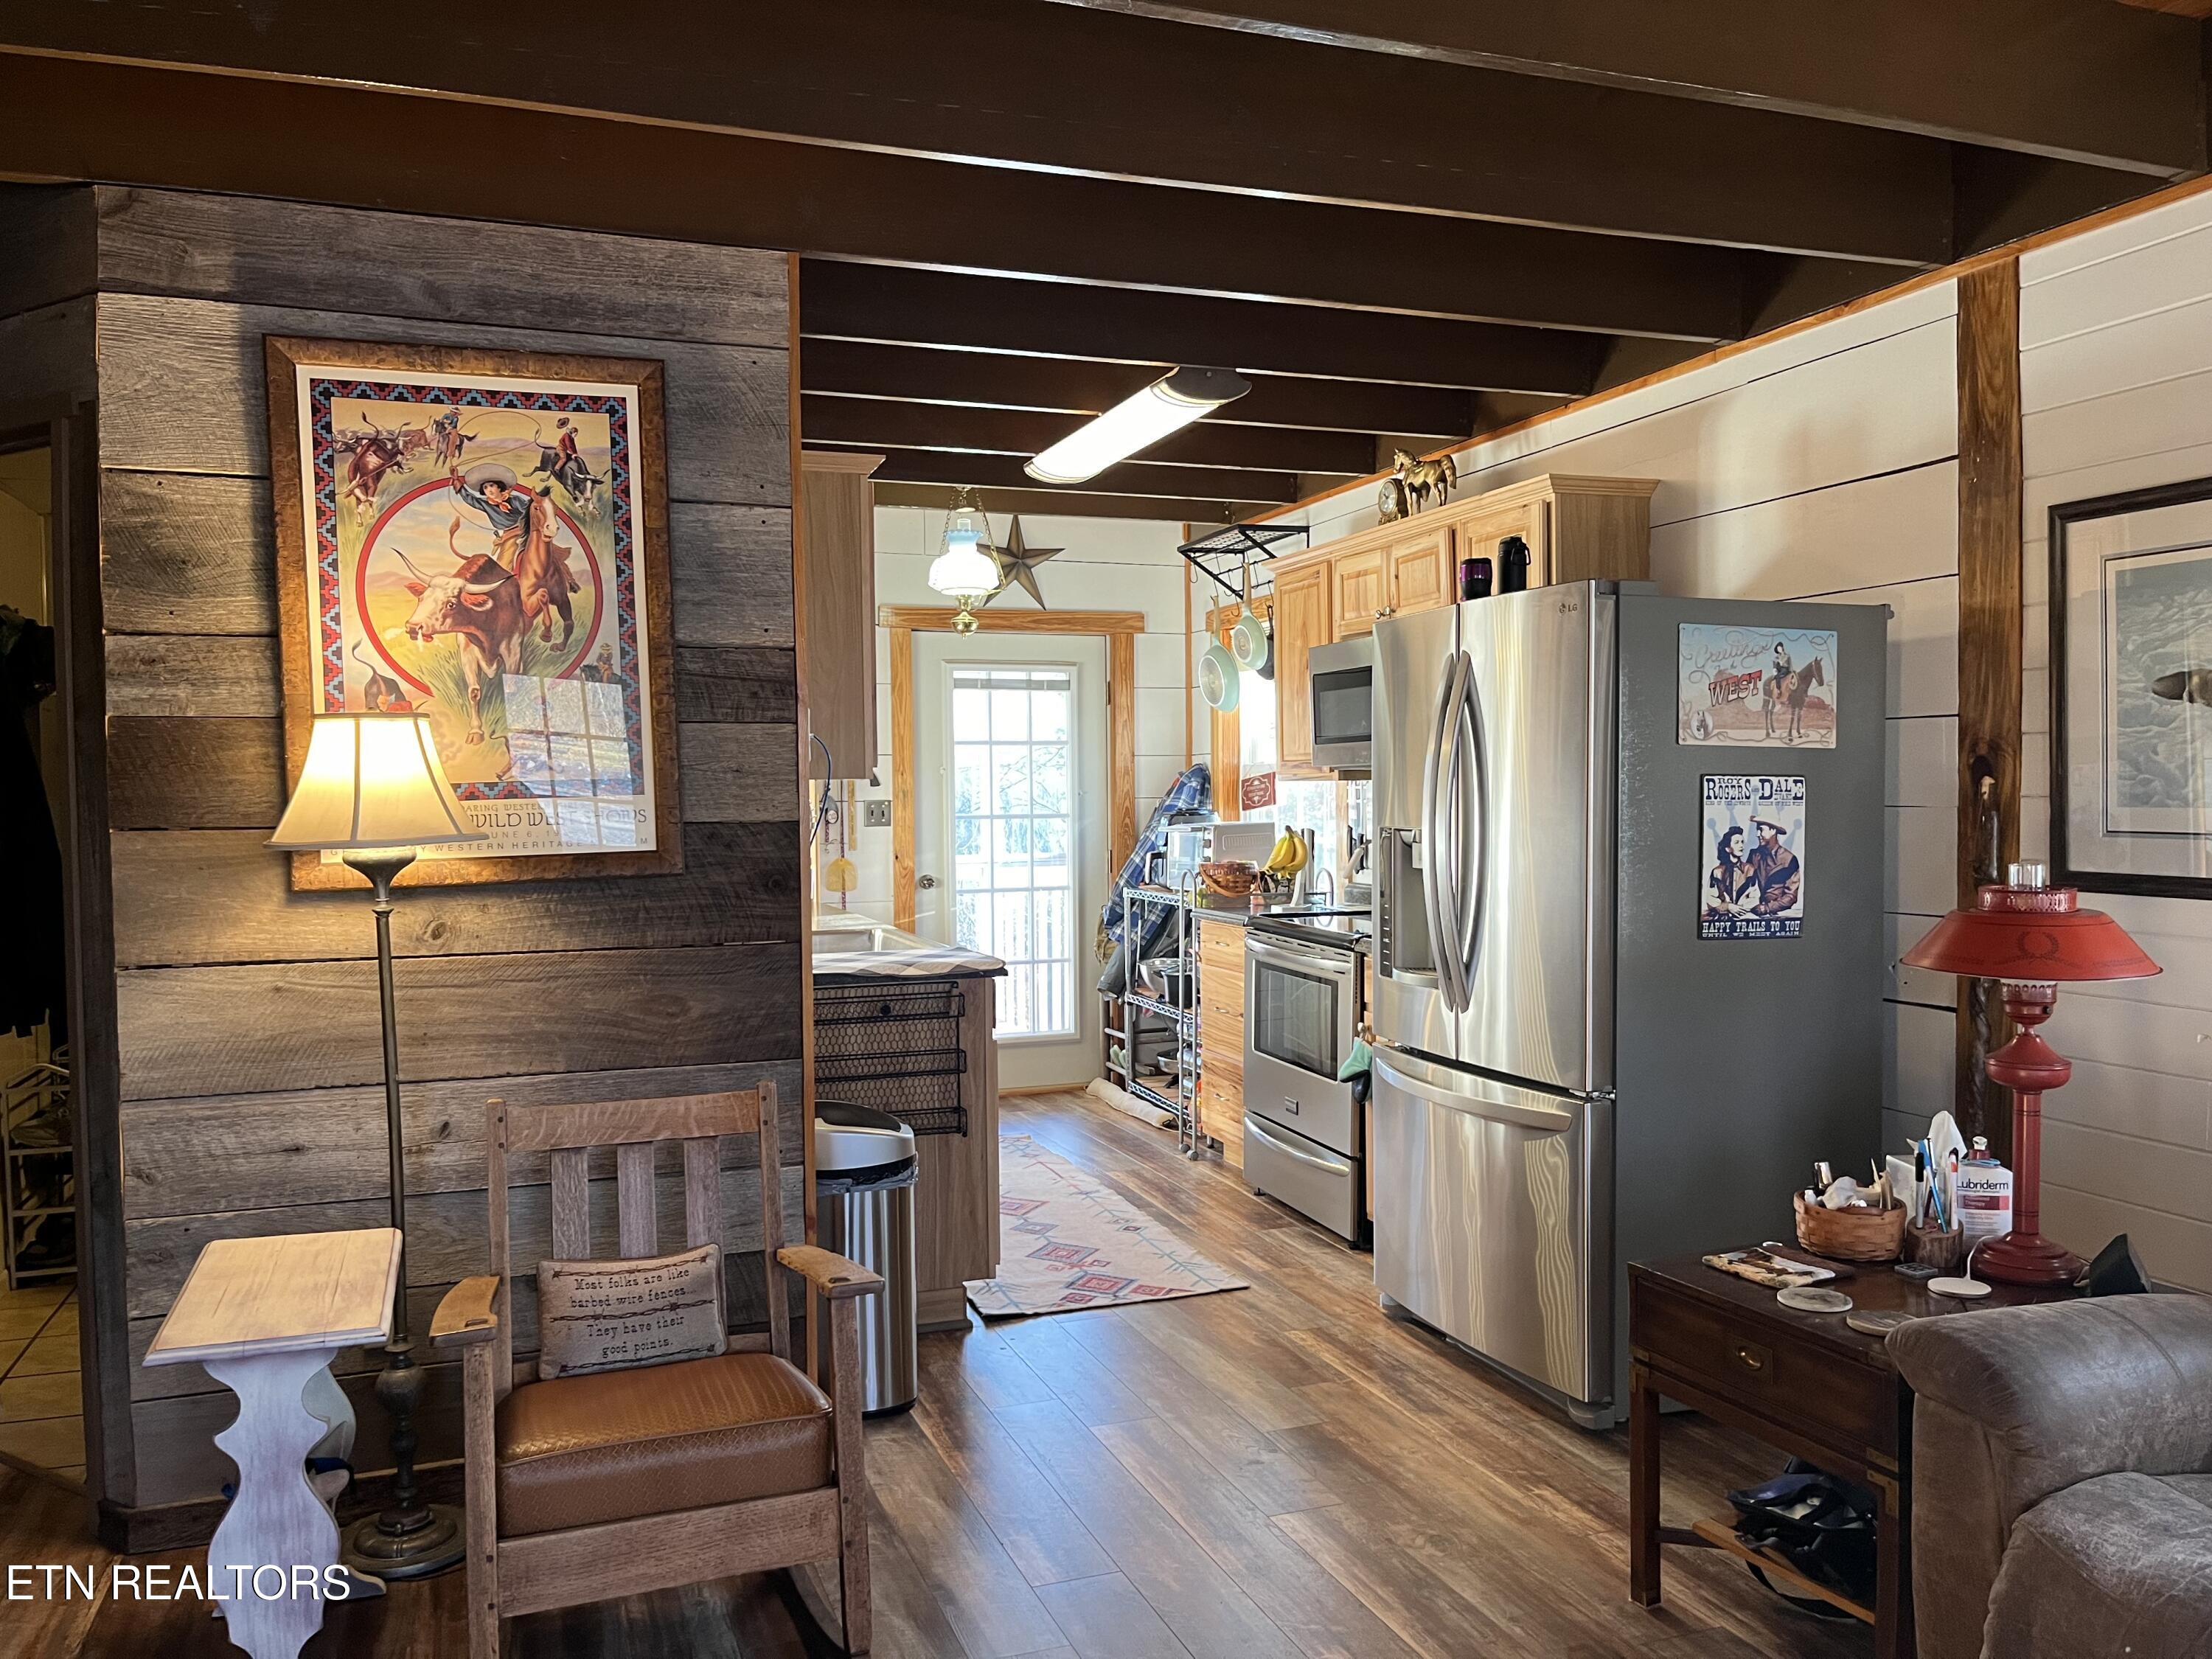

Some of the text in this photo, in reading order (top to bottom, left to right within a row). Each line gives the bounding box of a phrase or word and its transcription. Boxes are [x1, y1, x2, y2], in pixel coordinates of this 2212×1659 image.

[1568, 604, 1578, 612] LG
[1708, 669, 1762, 707] WEST
[1759, 778, 1804, 801] DALE
[462, 804, 498, 813] ARING
[470, 812, 521, 828] WILD
[491, 830, 518, 839] UNE
[435, 843, 504, 852] WESTERN
[512, 841, 584, 849] HERITAGE
[1703, 920, 1801, 933] HAPPY TRAILS TO YOU
[574, 1268, 690, 1290] Most folks are like
[570, 1295, 611, 1308] barbed
[616, 1293, 644, 1305] wire
[587, 1315, 684, 1339] They have their
[602, 1338, 673, 1358] good points.
